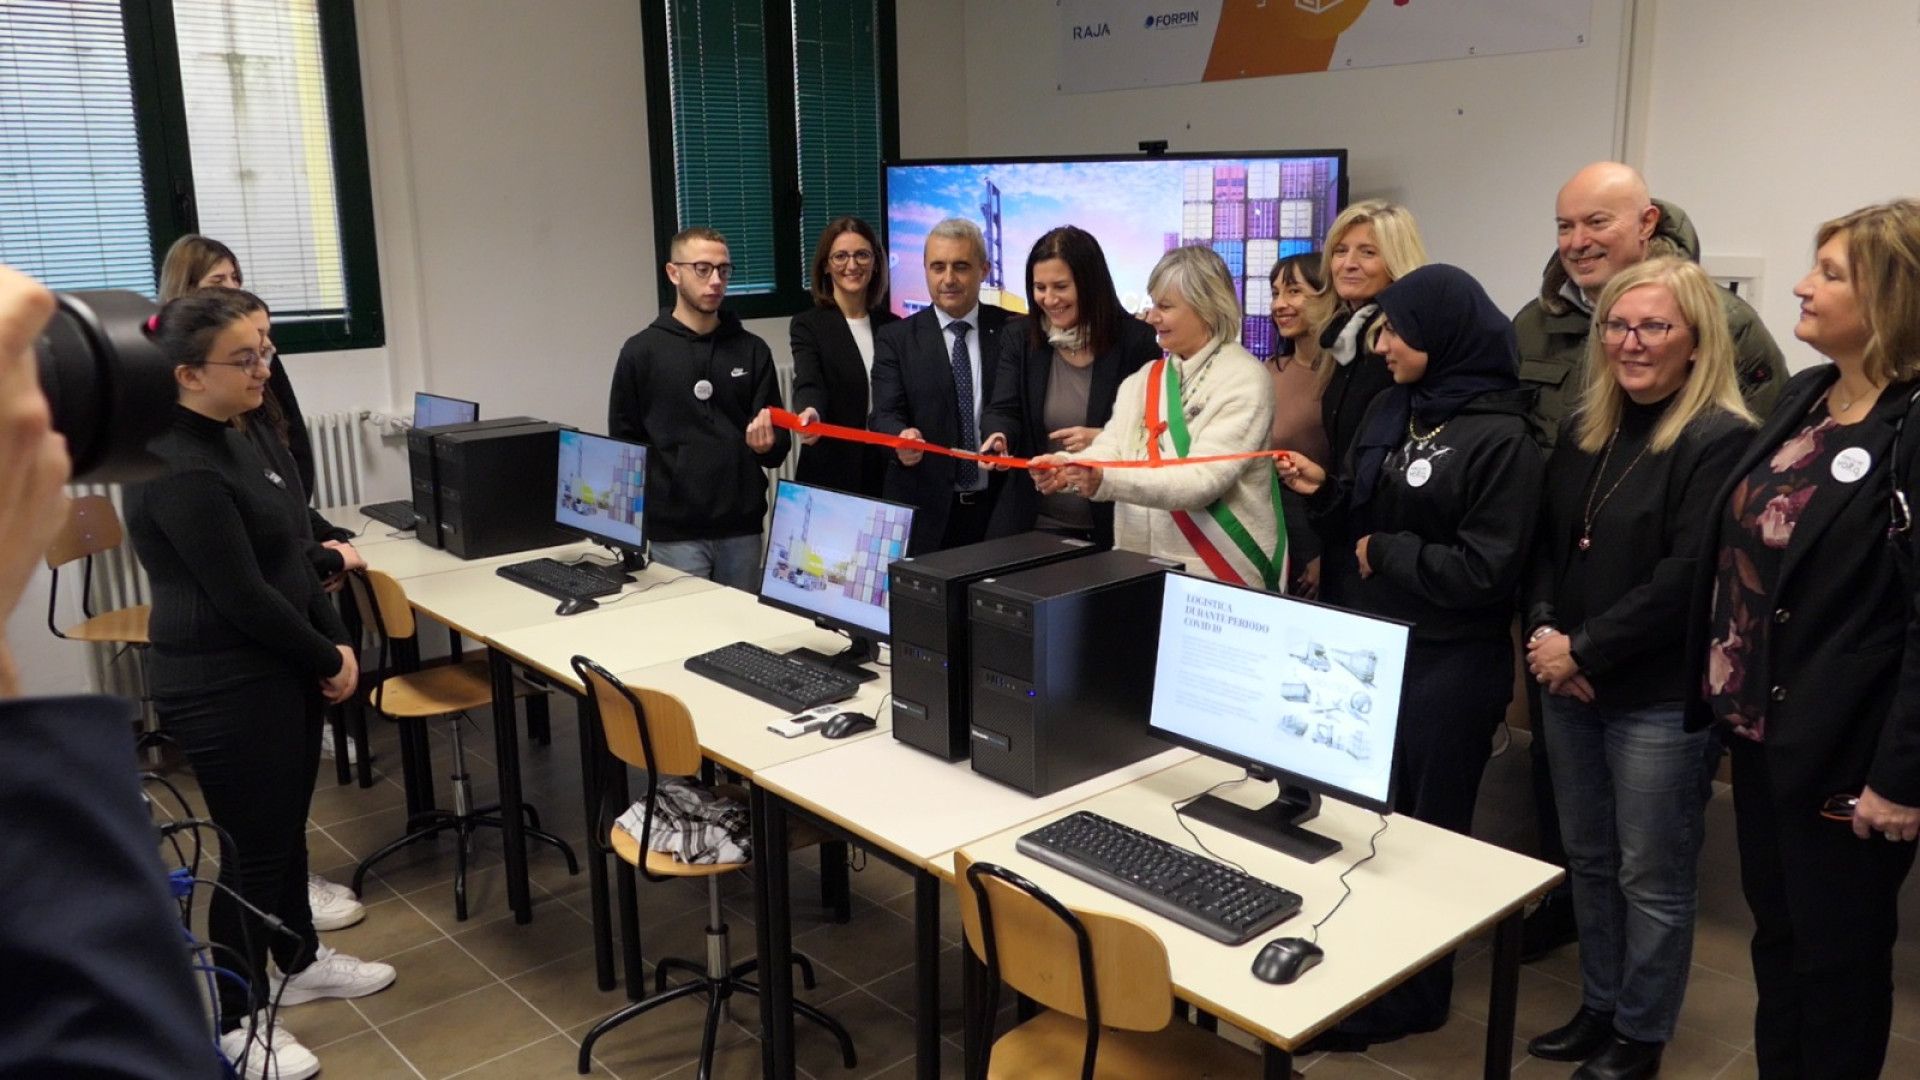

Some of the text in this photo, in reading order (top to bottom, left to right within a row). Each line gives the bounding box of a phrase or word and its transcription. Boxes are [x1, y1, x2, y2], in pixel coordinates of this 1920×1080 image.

[1155, 11, 1200, 27] FORPIN
[1073, 24, 1111, 40] RAJA
[1187, 593, 1232, 613] LOGISTICA
[1184, 616, 1223, 634] COVID 19
[1185, 605, 1270, 633] DURANTE PERIODO
